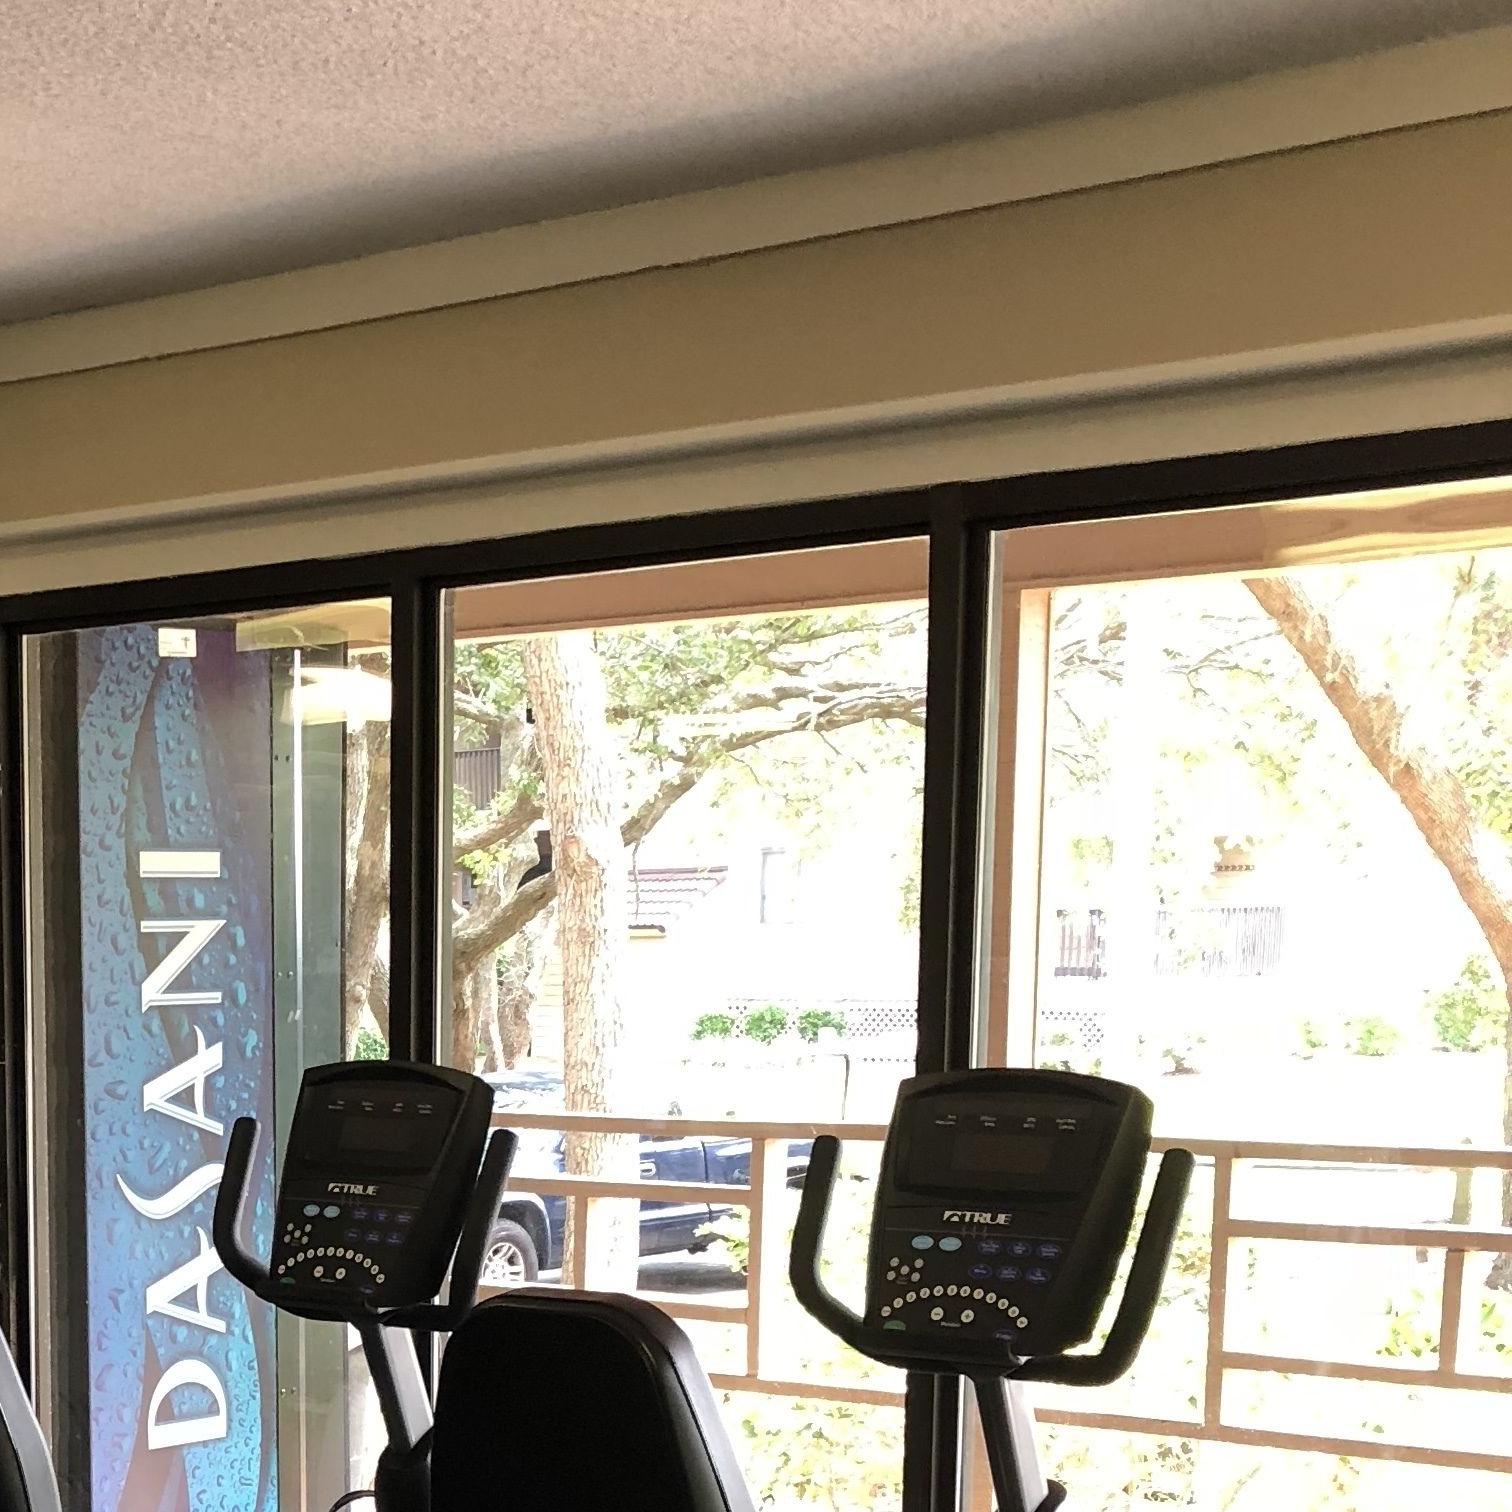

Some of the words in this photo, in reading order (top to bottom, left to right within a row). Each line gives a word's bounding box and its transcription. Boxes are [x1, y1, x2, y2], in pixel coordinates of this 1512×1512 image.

[116, 851, 227, 1451] DASANI
[342, 1183, 380, 1196] TRUE
[962, 1210, 1013, 1226] TRUE
